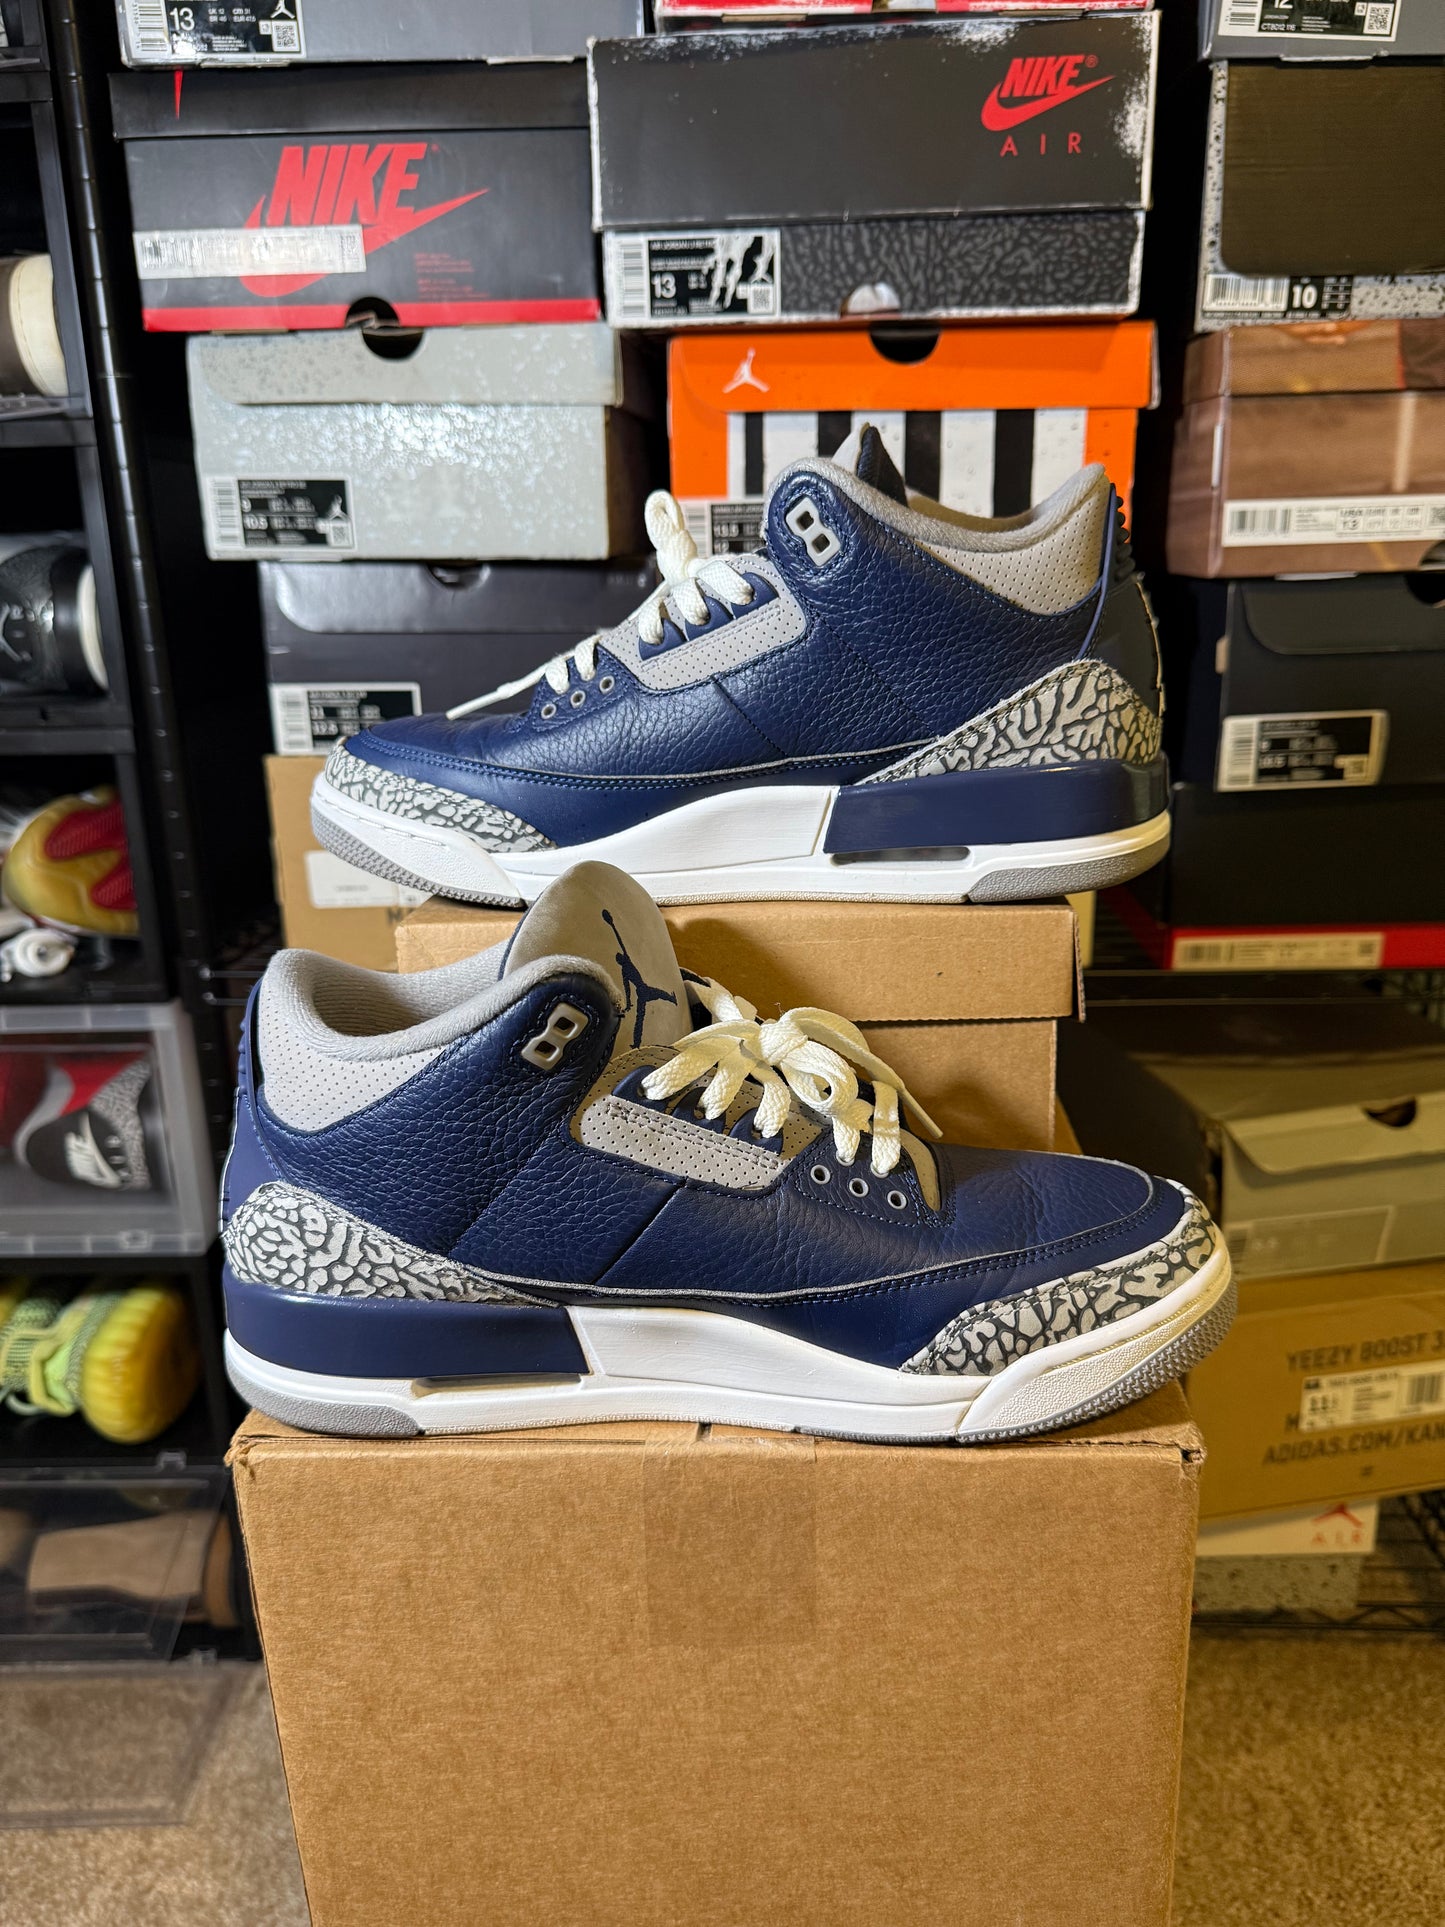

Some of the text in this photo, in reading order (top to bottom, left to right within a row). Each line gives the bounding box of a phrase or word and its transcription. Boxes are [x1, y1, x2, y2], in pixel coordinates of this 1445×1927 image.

[169, 7, 195, 32] 13
[1001, 54, 1086, 98] NIKE
[1000, 132, 1083, 157] AIR
[266, 142, 428, 226] NIKE
[651, 272, 677, 299] 13
[1292, 284, 1318, 309] 10
[1286, 1343, 1354, 1371] YEEZY
[1359, 1332, 1428, 1362] BOOST
